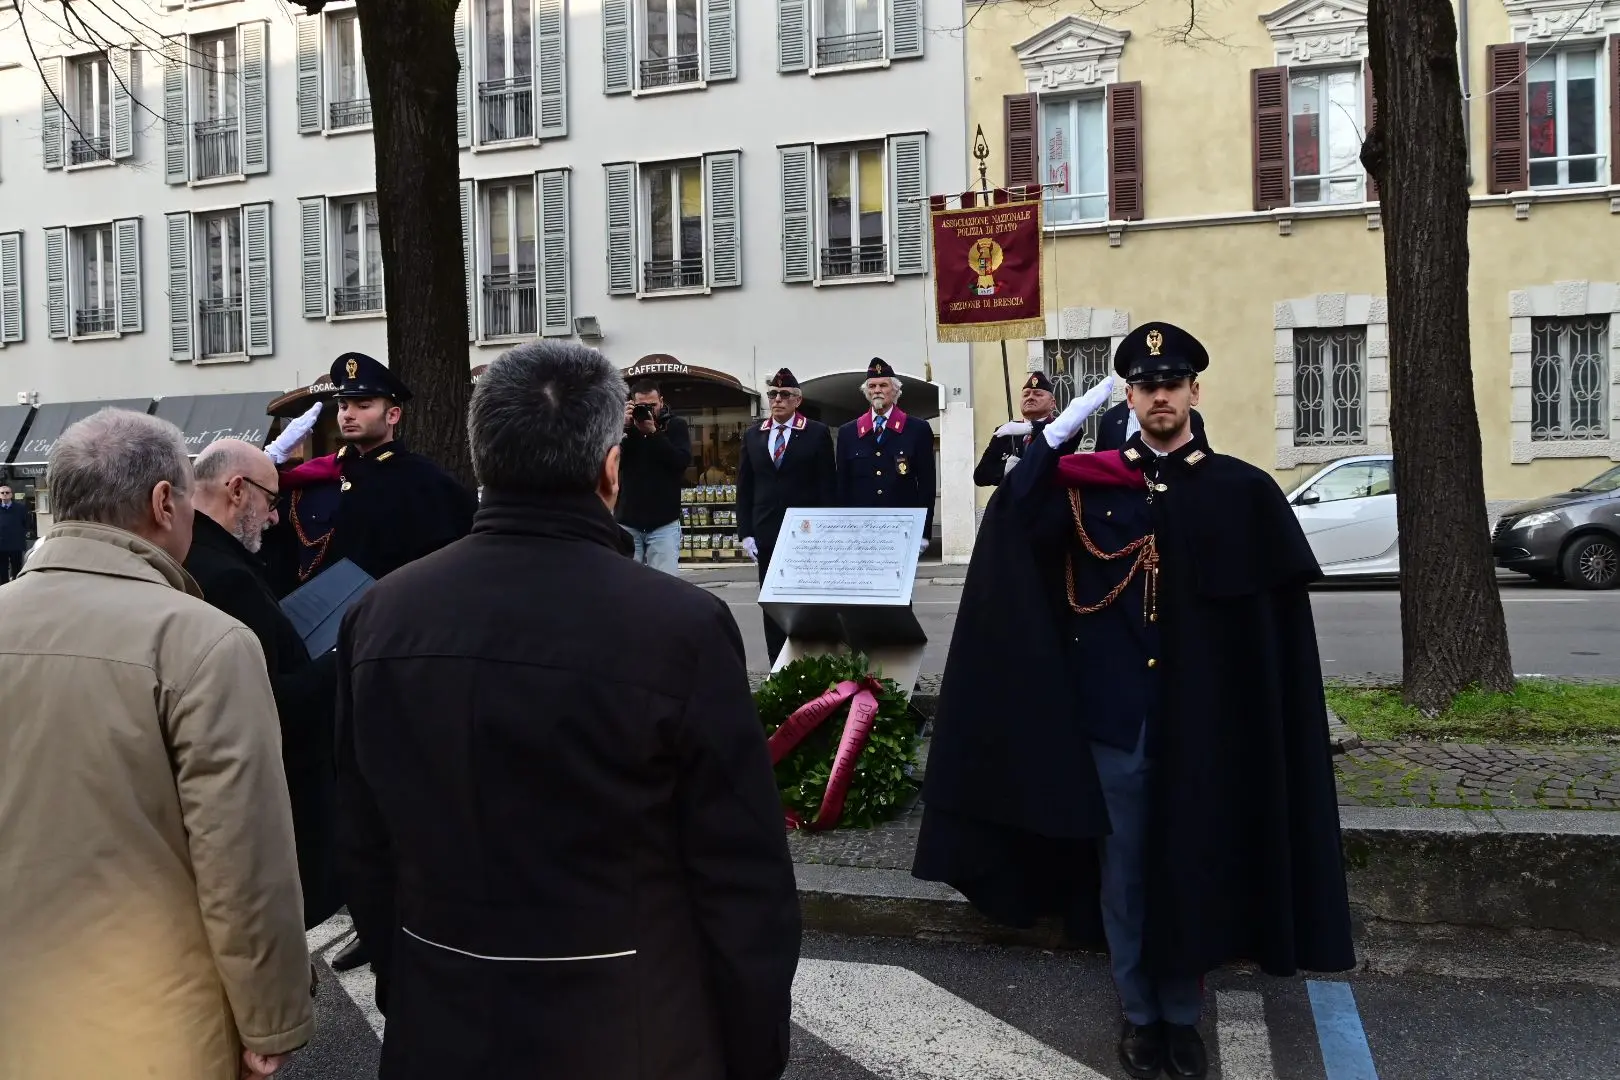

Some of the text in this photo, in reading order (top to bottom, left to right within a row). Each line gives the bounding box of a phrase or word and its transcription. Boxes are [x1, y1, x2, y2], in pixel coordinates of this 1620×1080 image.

[941, 210, 1031, 228] ASSOCIAZIONE NAZIONALE
[957, 222, 1018, 237] POLIZIA DI STATO
[949, 296, 1024, 311] SEZIONE DI BRESCIA
[628, 363, 689, 376] CAFFETTERIA
